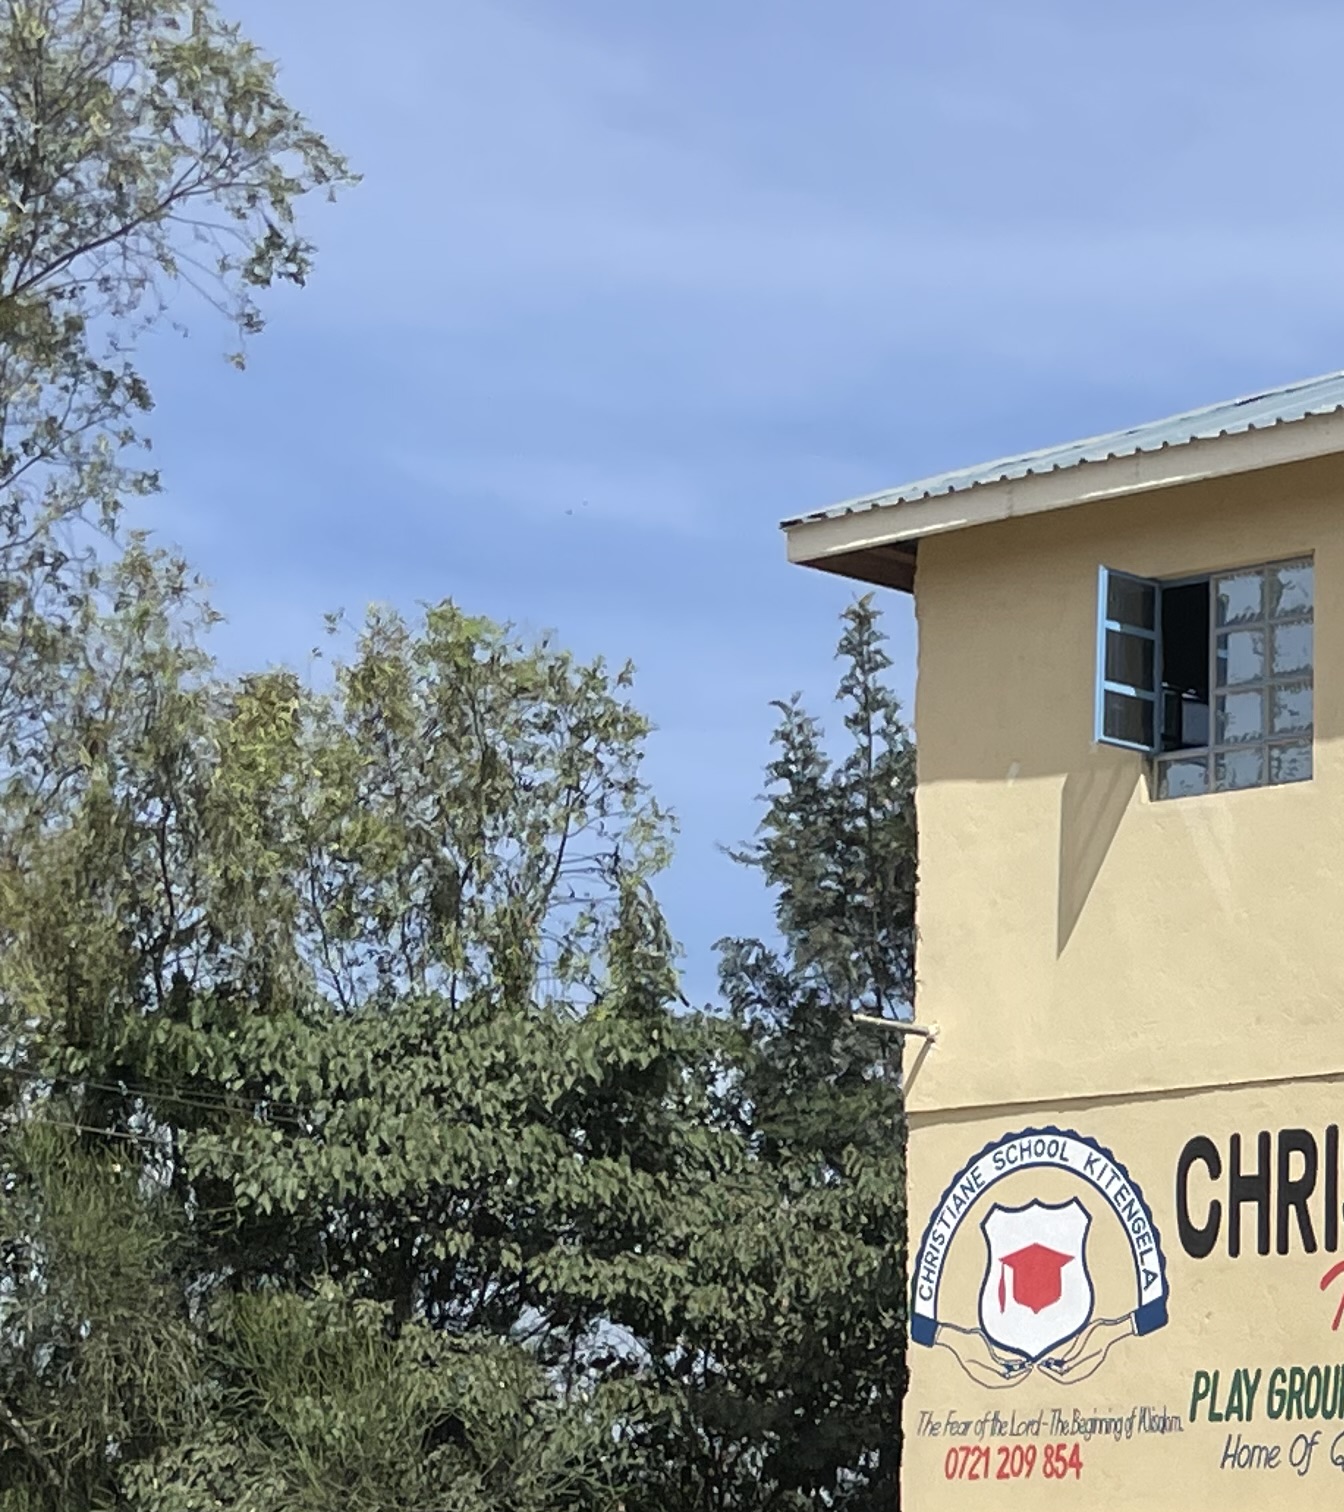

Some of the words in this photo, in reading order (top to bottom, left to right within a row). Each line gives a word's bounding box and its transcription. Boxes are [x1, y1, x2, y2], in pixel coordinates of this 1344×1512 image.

[917, 1167, 986, 1302] CHRISTIANE
[992, 1138, 1070, 1171] SCHOOL
[1082, 1151, 1160, 1291] KITENGELA
[1189, 1367, 1262, 1422] PLAY
[916, 1410, 940, 1437] The
[945, 1410, 973, 1437] Fear
[974, 1410, 991, 1441] of
[989, 1410, 1009, 1437] the
[1071, 1408, 1122, 1442] Beginning
[1123, 1407, 1136, 1440] of
[944, 1446, 990, 1481] 0721
[996, 1444, 1037, 1479] 209
[1042, 1442, 1083, 1480] 854
[1220, 1433, 1281, 1470] Home
[1289, 1431, 1322, 1476] Of
